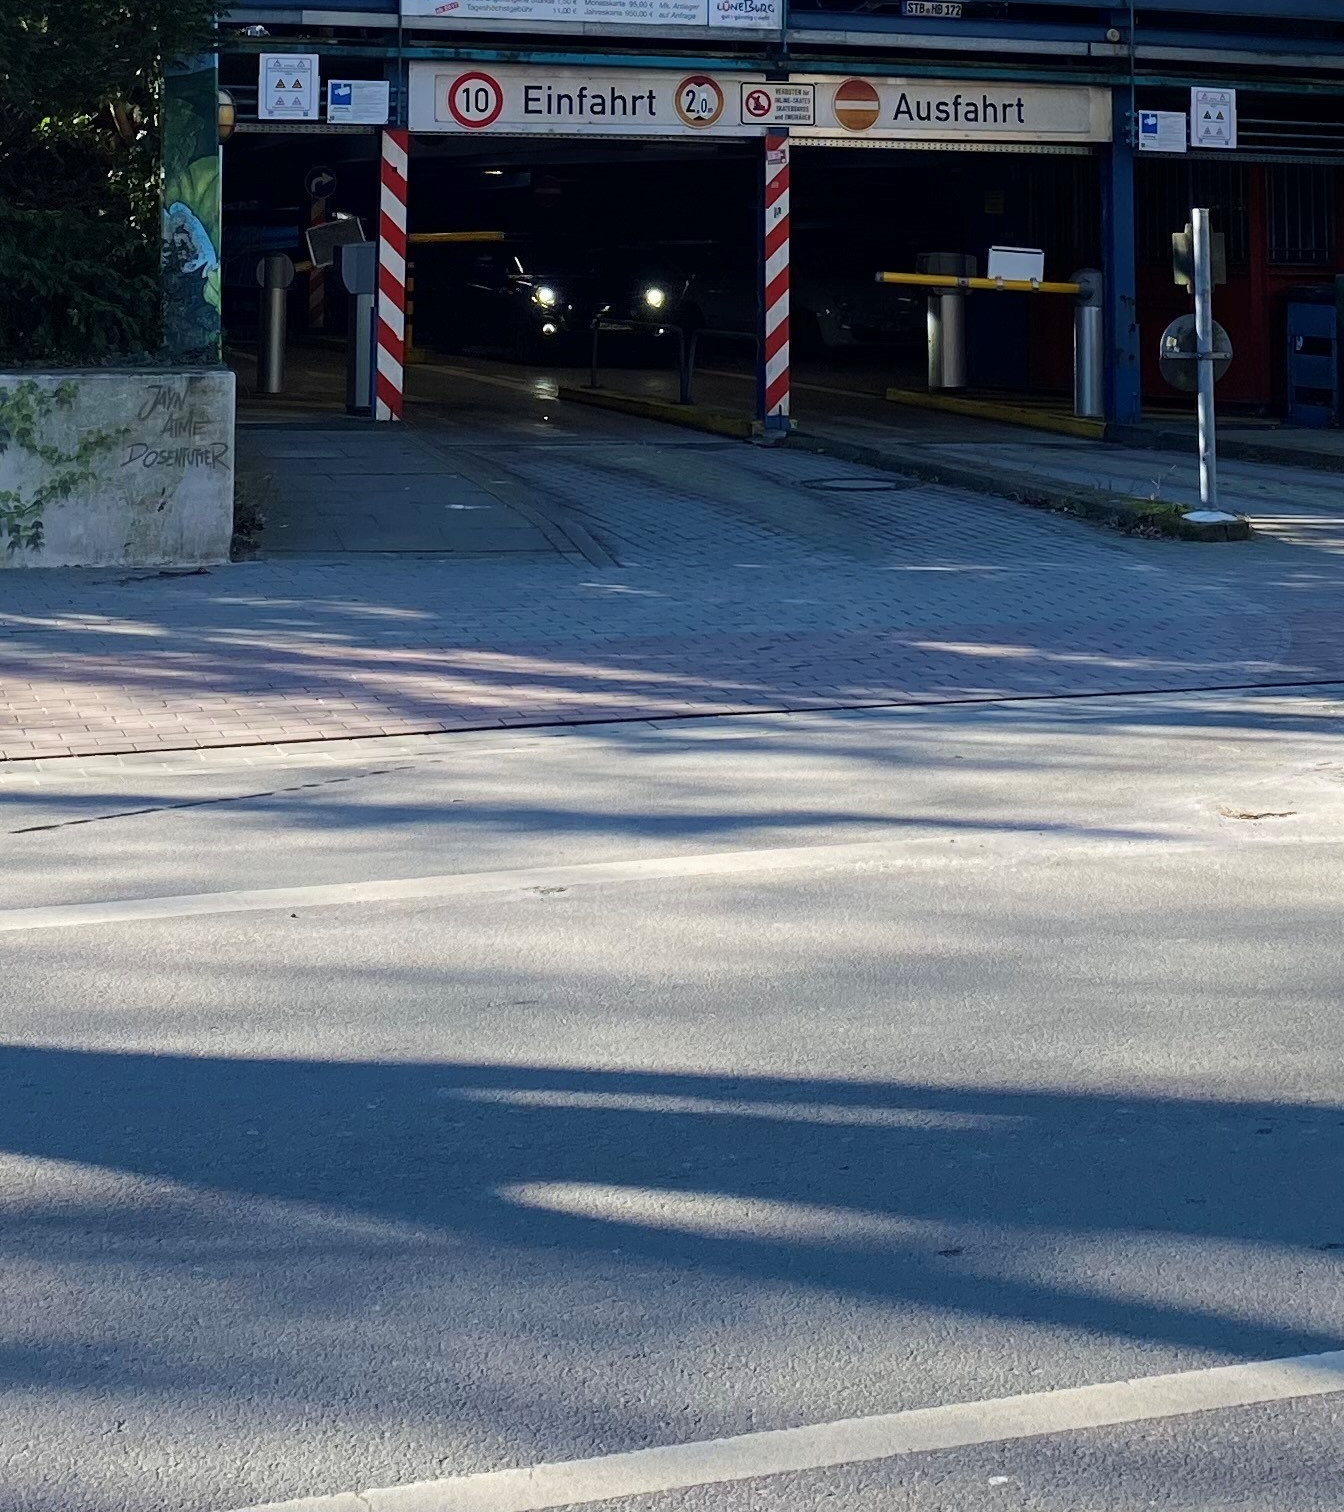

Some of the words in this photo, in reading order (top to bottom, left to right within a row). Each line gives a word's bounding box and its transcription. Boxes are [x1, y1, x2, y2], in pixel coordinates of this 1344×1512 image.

[945, 4, 961, 16] 172
[462, 87, 489, 114] 10
[523, 85, 657, 117] Einfahrt
[893, 92, 1025, 124] Ausfahrt
